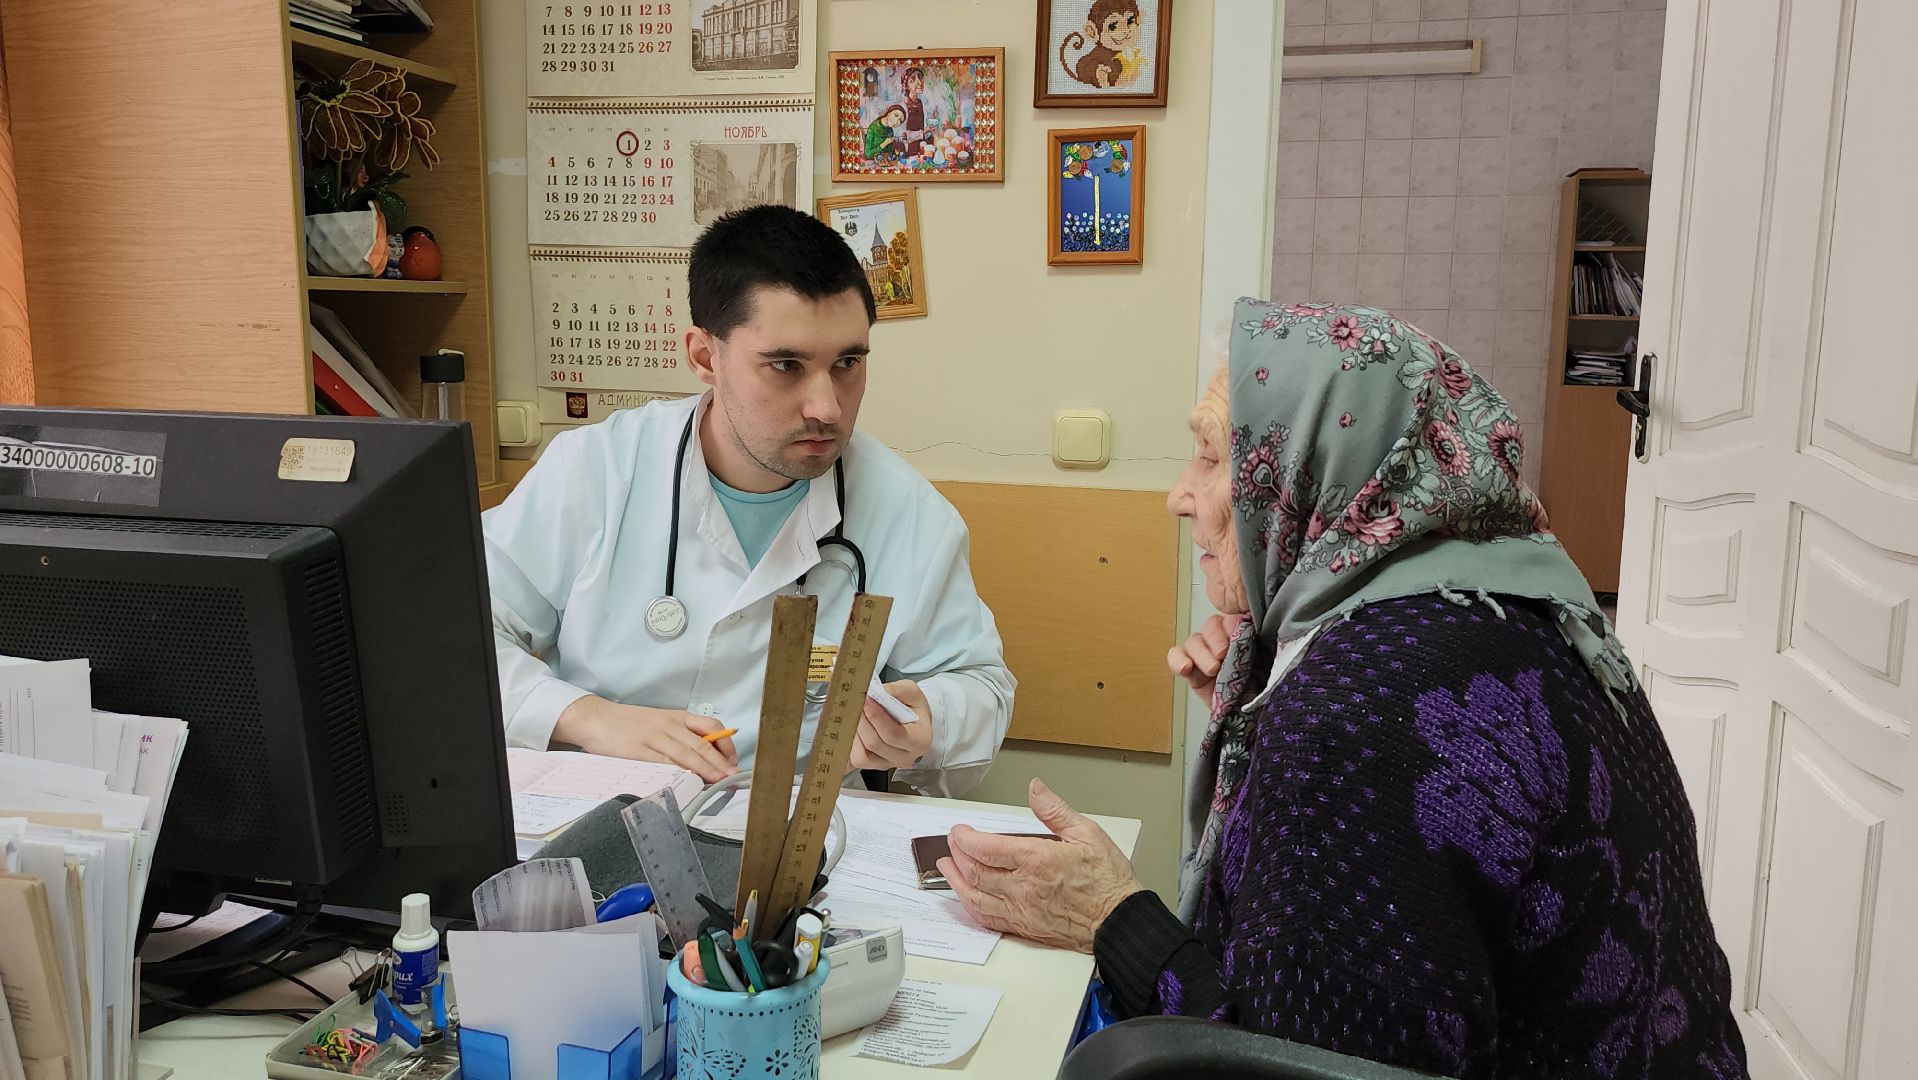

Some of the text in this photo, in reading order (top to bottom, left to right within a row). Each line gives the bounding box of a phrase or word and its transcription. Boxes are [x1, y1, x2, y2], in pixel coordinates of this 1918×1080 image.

[545, 3, 671, 17] 7 8 9 10 11 12 13
[543, 23, 672, 35] 14 15 16 17 18 19 20
[543, 41, 671, 54] 21 22 23 24 25 26 27
[542, 61, 614, 72] 28 29 30 31
[724, 126, 768, 138] НОЯБРЬ
[625, 140, 670, 151] 1 2 3
[547, 157, 673, 168] 4 5 6 7 8 9 10
[547, 175, 673, 187] 11 12 13 14 15 16 17
[546, 192, 674, 205] 18 19 20 21 22 23 24
[545, 210, 656, 223] 25 26 27 28 29 30
[666, 288, 671, 298] 1
[552, 302, 672, 316] 2 3 4 5 6 7 8
[552, 319, 675, 334] 9 10 11 12 13 14 15
[551, 337, 676, 351] 16 17 18 19 20 21 22
[551, 354, 676, 368] 23 24 25 26 27 28 29
[551, 371, 583, 382] 30 31
[0, 446, 155, 476] 34000000608-10
[865, 600, 874, 609] 30
[842, 683, 850, 691] 25
[818, 764, 826, 772] 20
